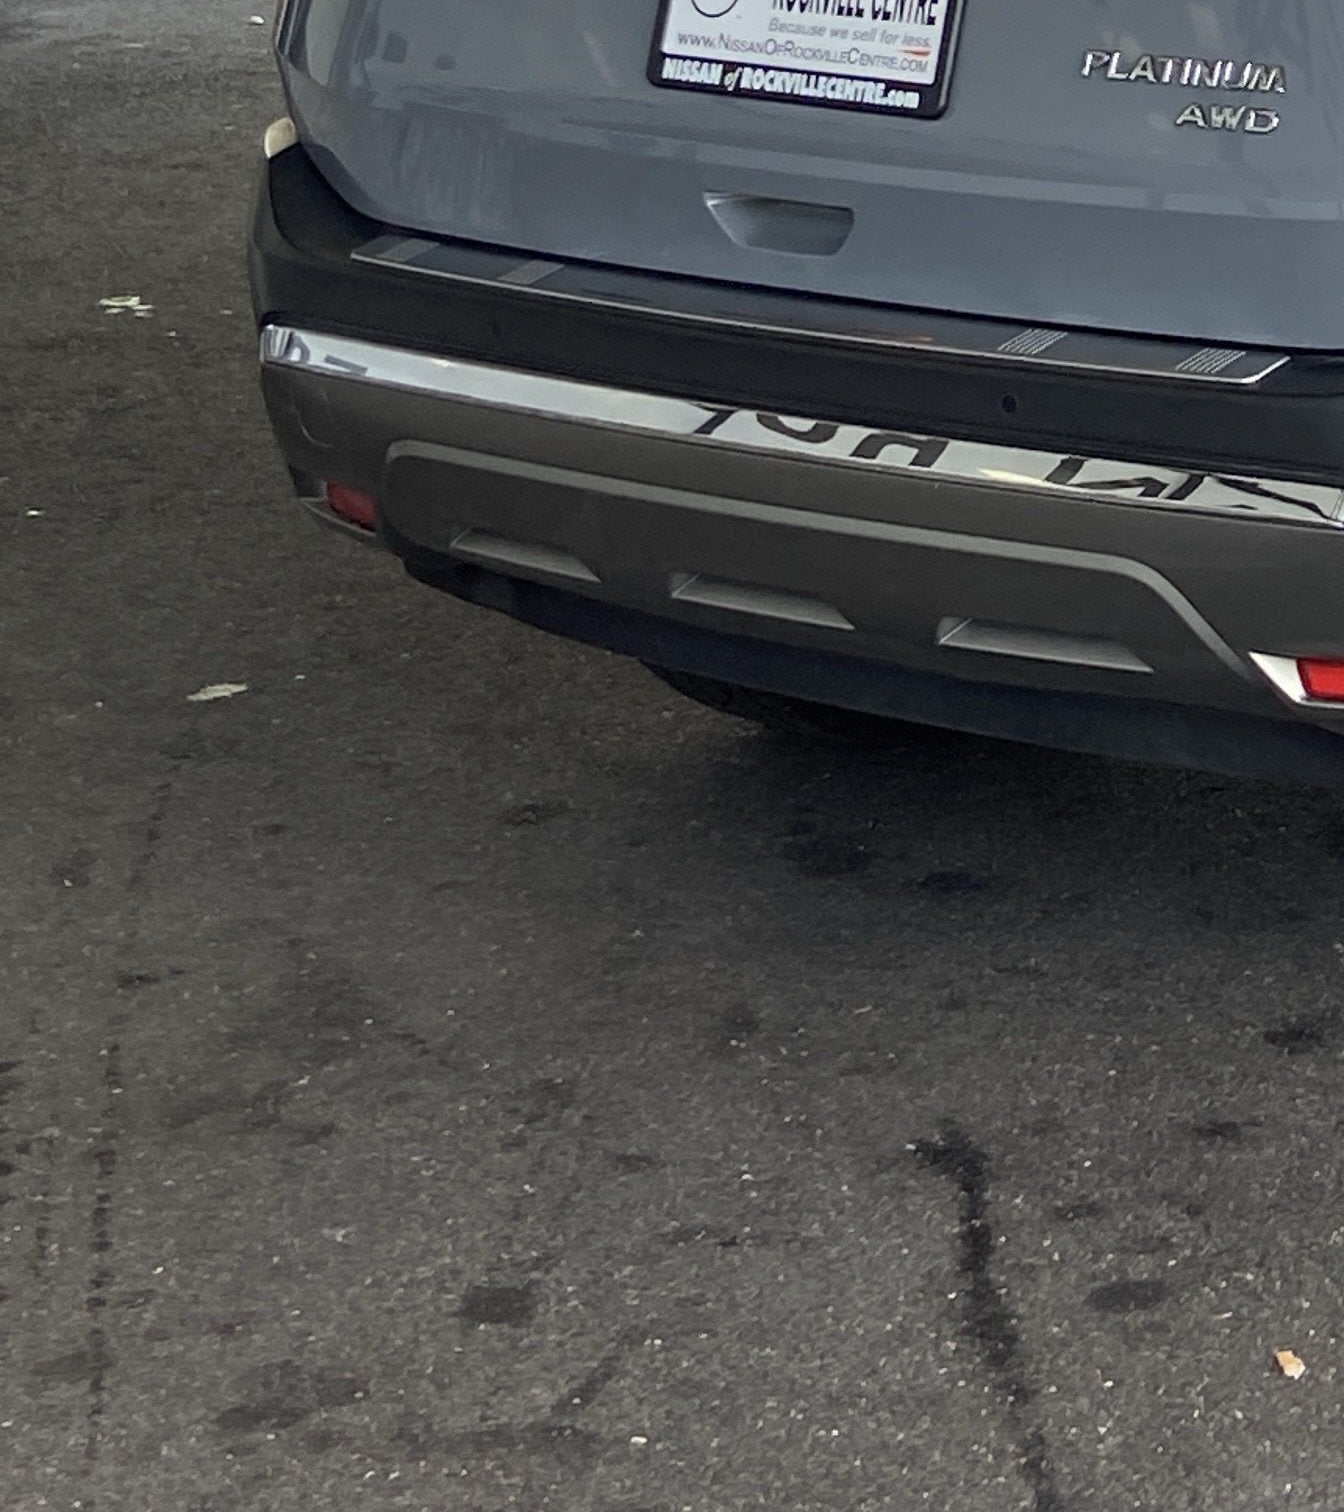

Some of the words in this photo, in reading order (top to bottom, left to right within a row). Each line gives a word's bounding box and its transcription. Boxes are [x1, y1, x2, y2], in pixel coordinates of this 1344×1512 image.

[768, 17, 826, 37] Because
[829, 28, 850, 40] we
[851, 29, 877, 43] sell
[879, 30, 899, 45] for
[661, 58, 723, 85] NISSAN
[1081, 49, 1288, 93] PLATINUM
[1175, 102, 1282, 134] AWD
